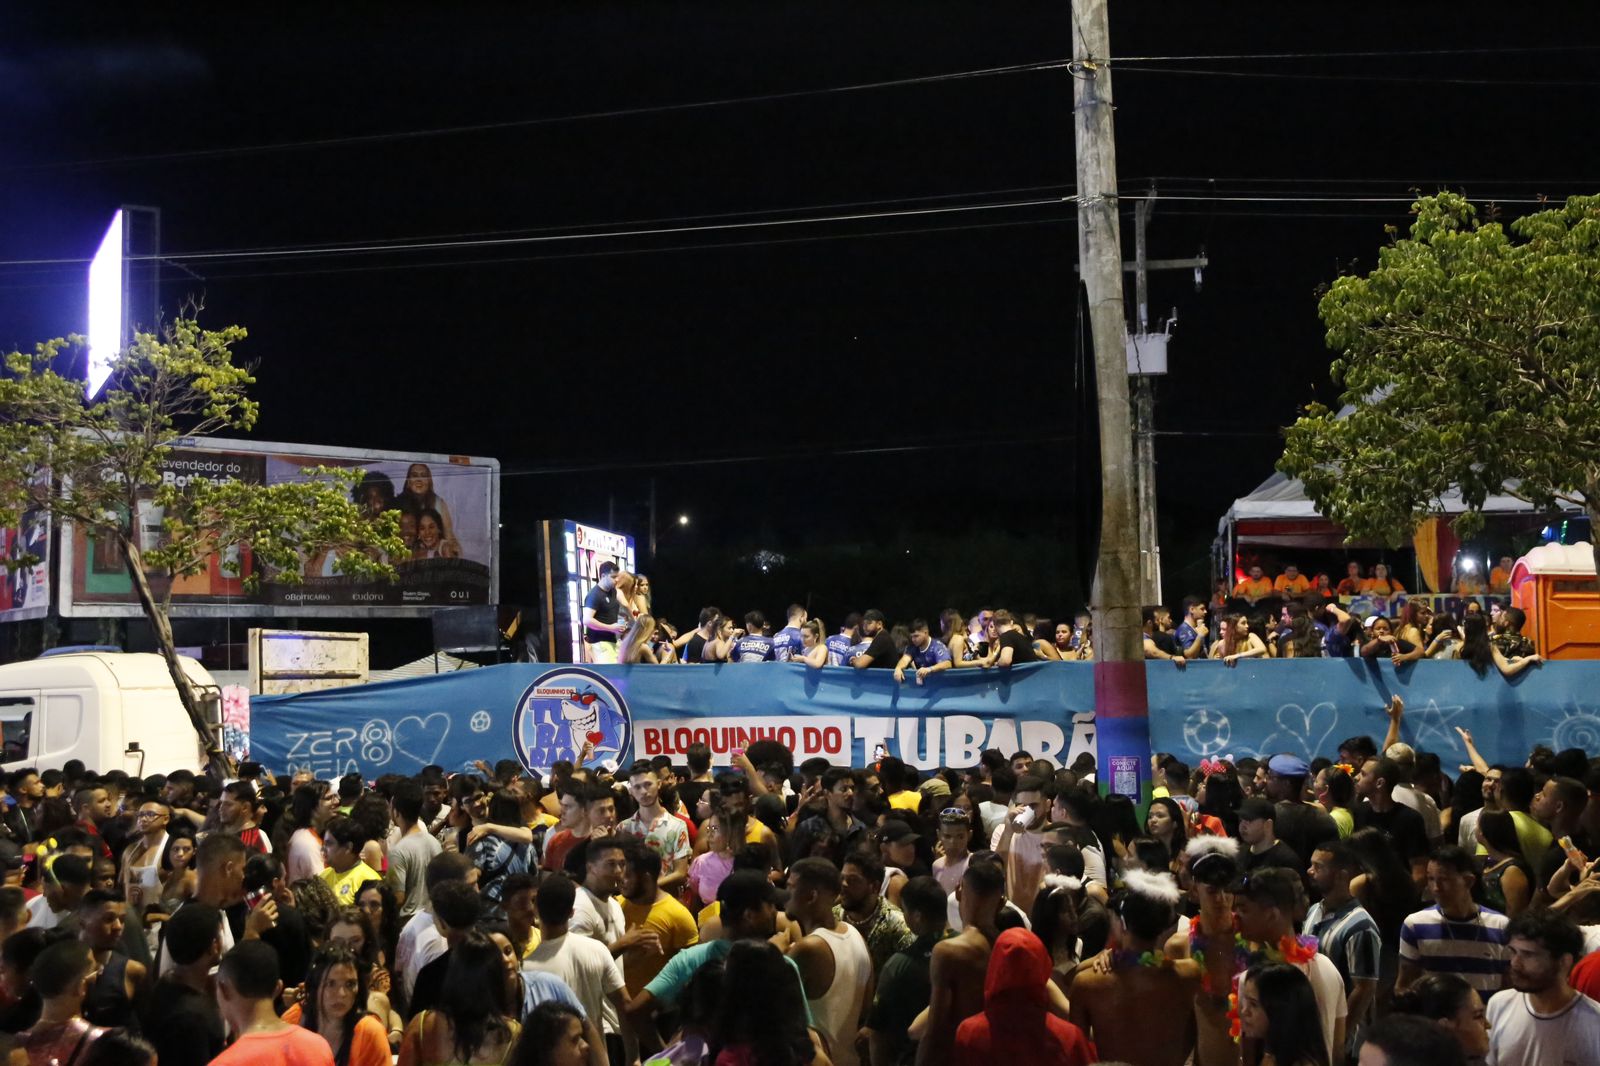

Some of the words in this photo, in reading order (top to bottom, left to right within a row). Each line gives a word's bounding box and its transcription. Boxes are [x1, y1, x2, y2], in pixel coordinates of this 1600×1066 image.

[158, 459, 224, 473] evendedor
[226, 462, 241, 473] do
[644, 726, 797, 756] BLOQUINHO
[803, 726, 842, 755] DO
[853, 711, 1097, 772] TUBARÃ
